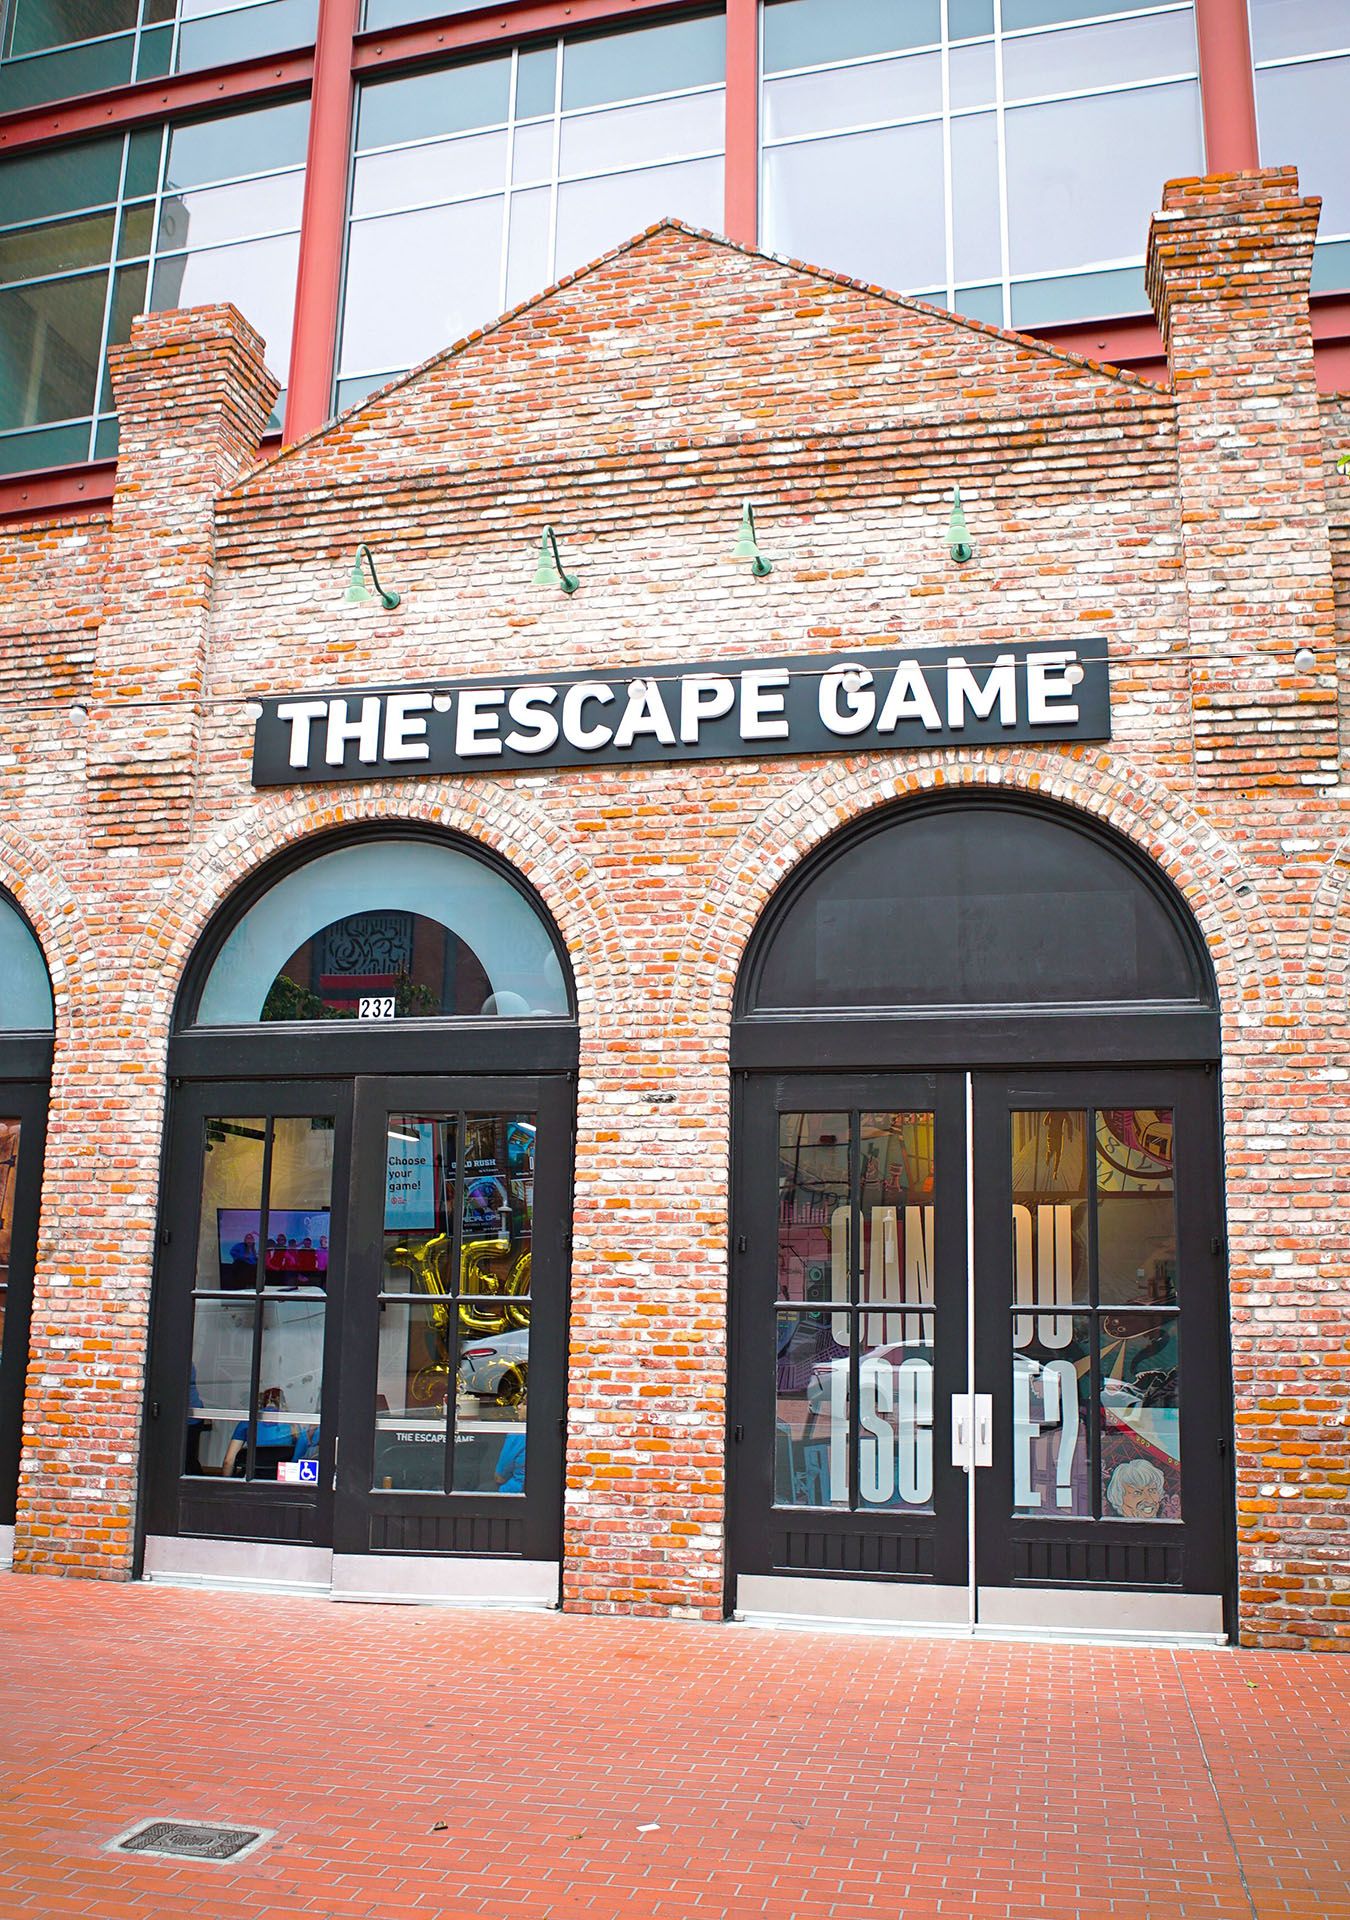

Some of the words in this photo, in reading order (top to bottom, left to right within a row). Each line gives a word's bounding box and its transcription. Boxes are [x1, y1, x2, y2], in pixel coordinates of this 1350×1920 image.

[276, 693, 431, 769] THE
[455, 667, 790, 758] ESCAPE
[818, 650, 1081, 736] GAME
[361, 998, 393, 1018] 232
[388, 1156, 427, 1166] Choose
[451, 1160, 473, 1169] GLD
[473, 1158, 497, 1167] RUSH
[388, 1170, 413, 1180] your
[388, 1180, 421, 1193] game!
[831, 1205, 934, 1348] CAN
[396, 1432, 414, 1441] THE
[414, 1432, 447, 1443] ESCAPE
